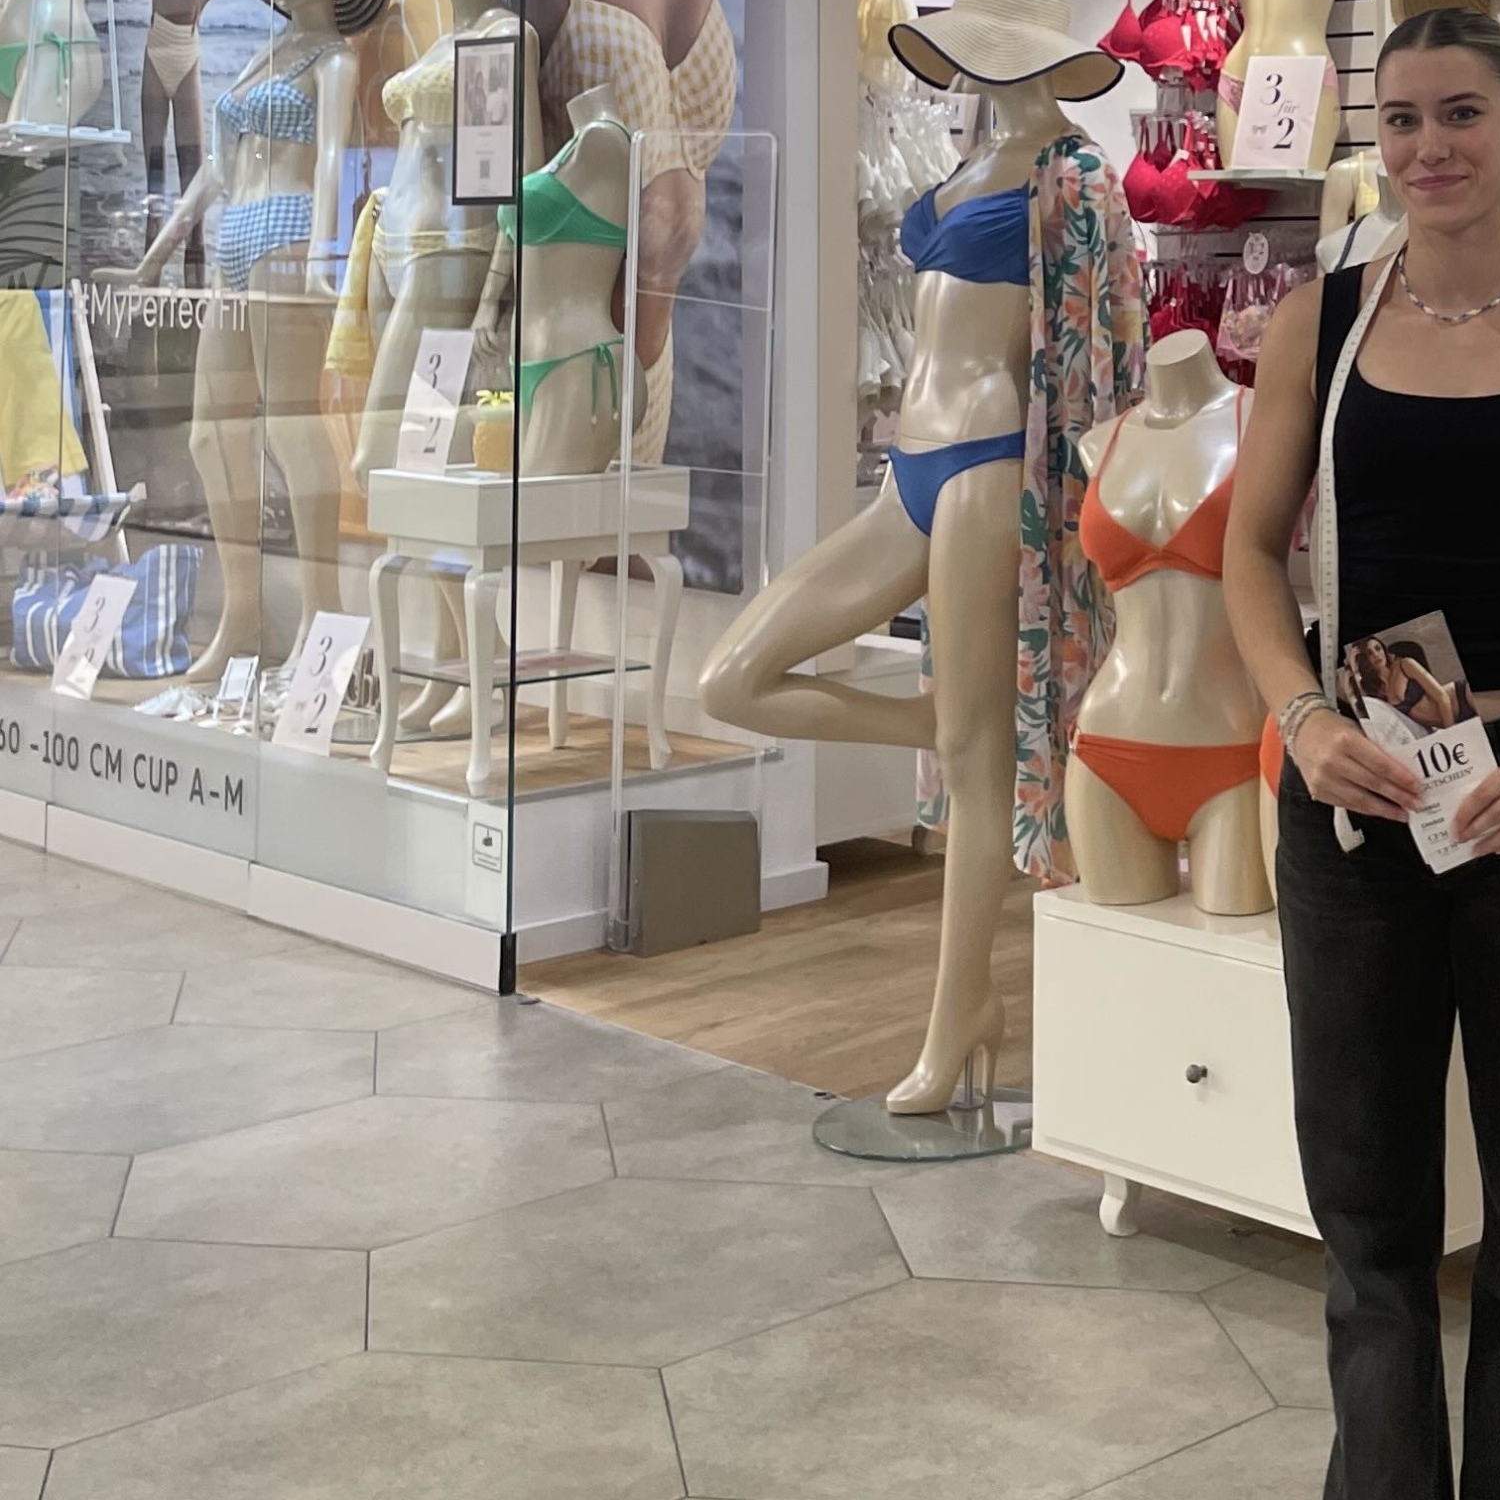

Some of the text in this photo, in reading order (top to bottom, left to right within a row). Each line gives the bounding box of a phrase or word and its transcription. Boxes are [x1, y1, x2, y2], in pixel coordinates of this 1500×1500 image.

[1260, 72, 1284, 106] 3
[1271, 116, 1295, 150] 2
[426, 353, 442, 389] 3
[423, 413, 441, 454] 2
[310, 635, 333, 678] 3
[304, 693, 327, 735] 2
[30, 730, 79, 771] -100
[90, 743, 123, 783] CM
[133, 753, 178, 795] CUP
[189, 767, 244, 815] A-M
[1412, 741, 1470, 779] 10€
